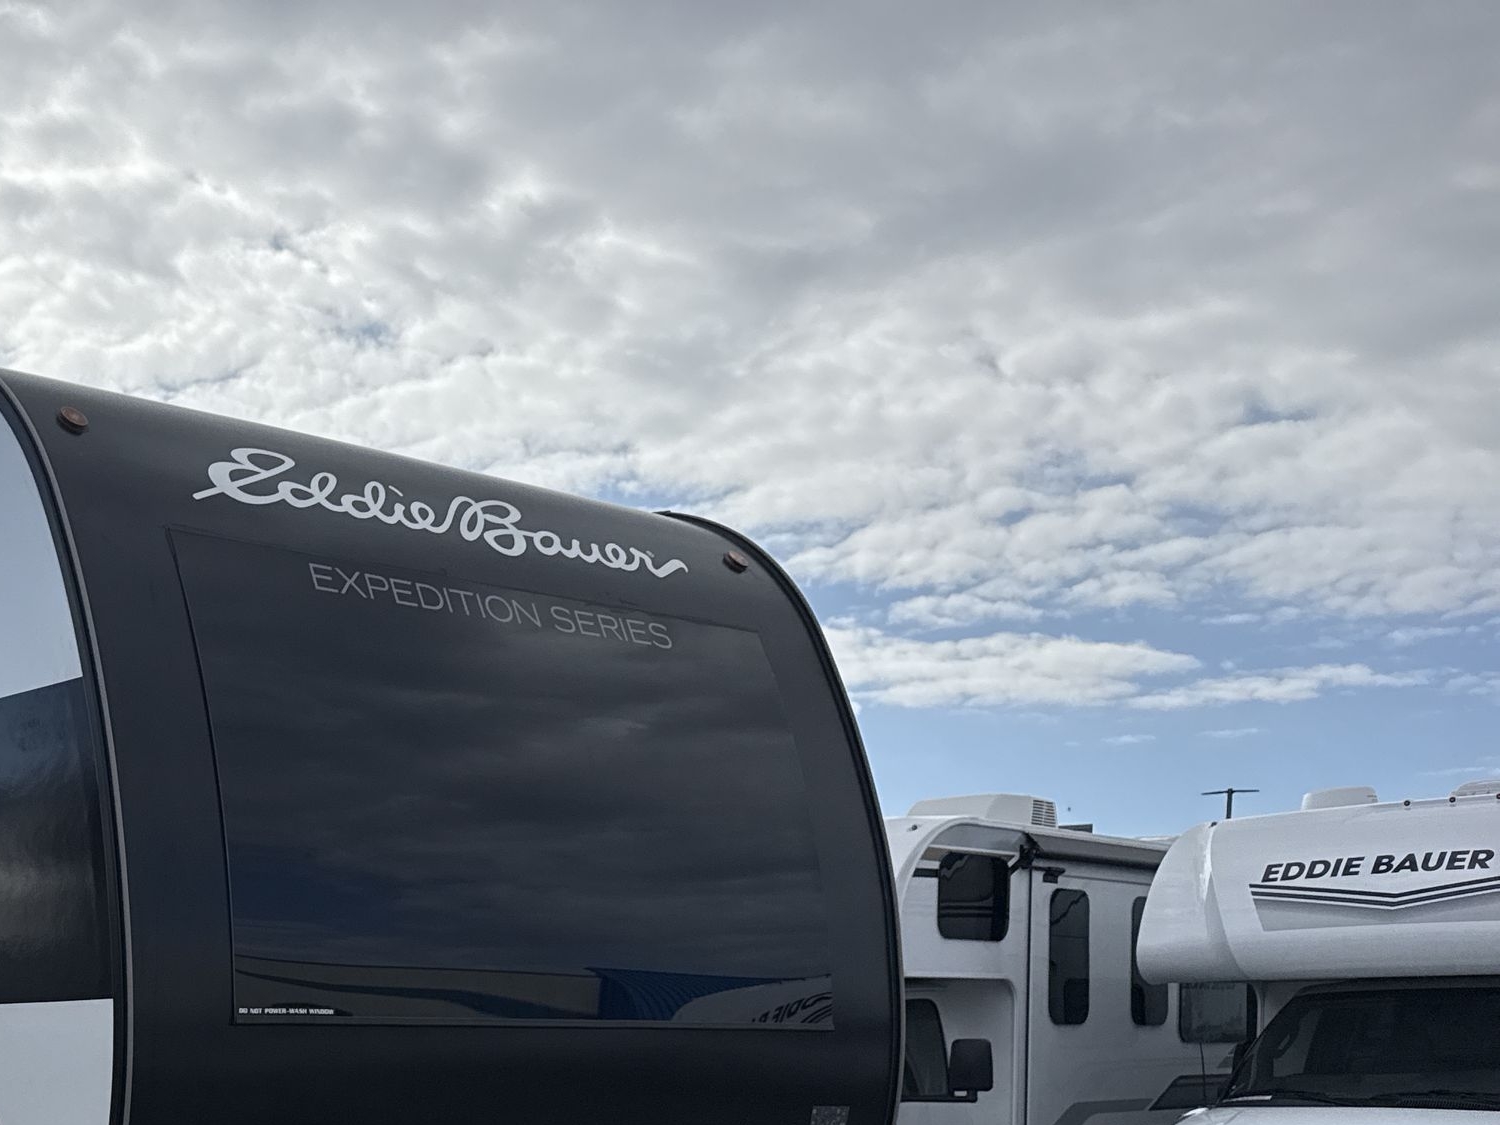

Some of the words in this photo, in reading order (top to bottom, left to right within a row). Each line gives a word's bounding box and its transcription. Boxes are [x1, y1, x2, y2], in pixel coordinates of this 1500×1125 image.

[192, 447, 452, 534] Eddie
[450, 495, 689, 578] Bauer
[308, 562, 542, 628] EXPEDITION
[550, 605, 673, 650] SERIES
[1261, 856, 1365, 883] EDDIE
[1370, 849, 1495, 875] BAUER
[249, 1007, 262, 1015] NOT
